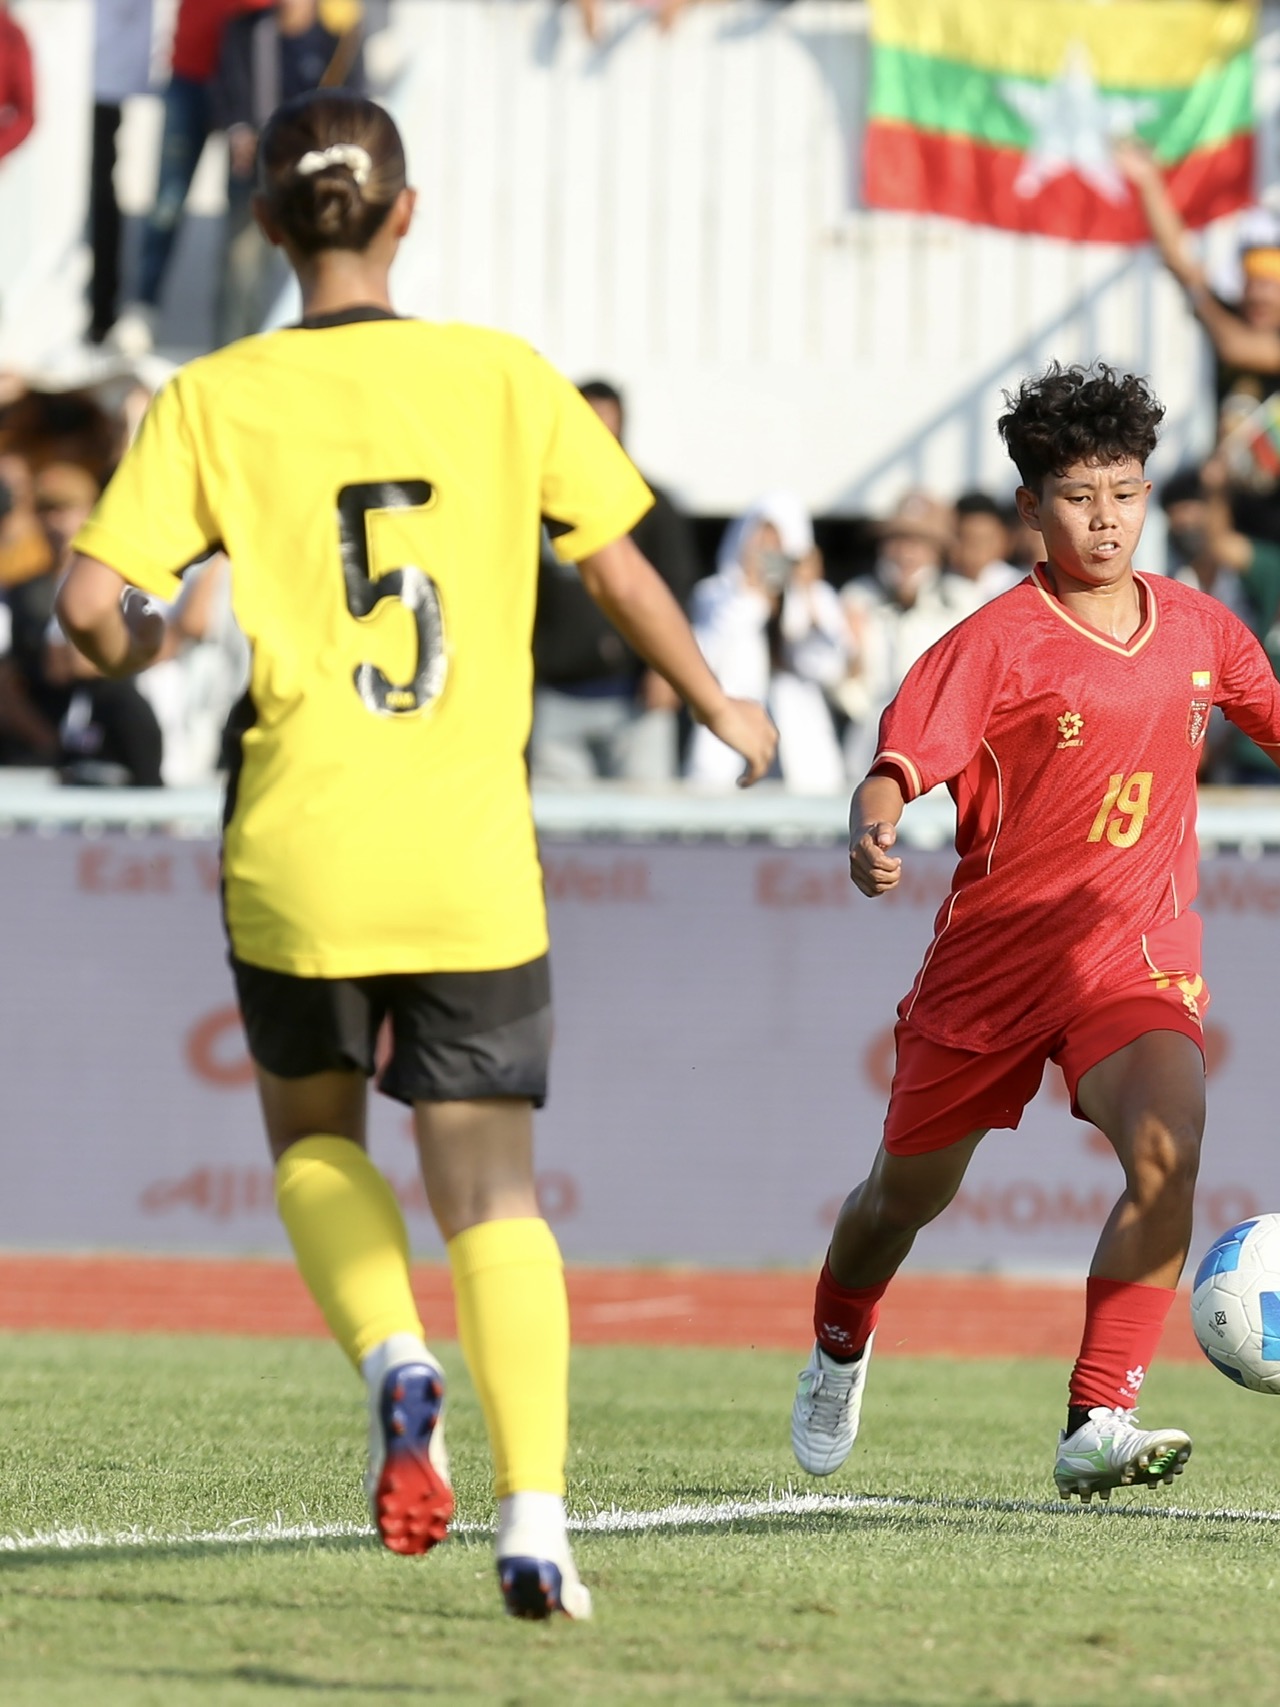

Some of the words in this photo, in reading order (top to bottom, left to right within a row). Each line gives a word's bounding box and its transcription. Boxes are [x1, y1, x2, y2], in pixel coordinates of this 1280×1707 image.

[336, 479, 449, 714] 5
[1087, 772, 1153, 848] 19
[77, 846, 173, 896] Eat
